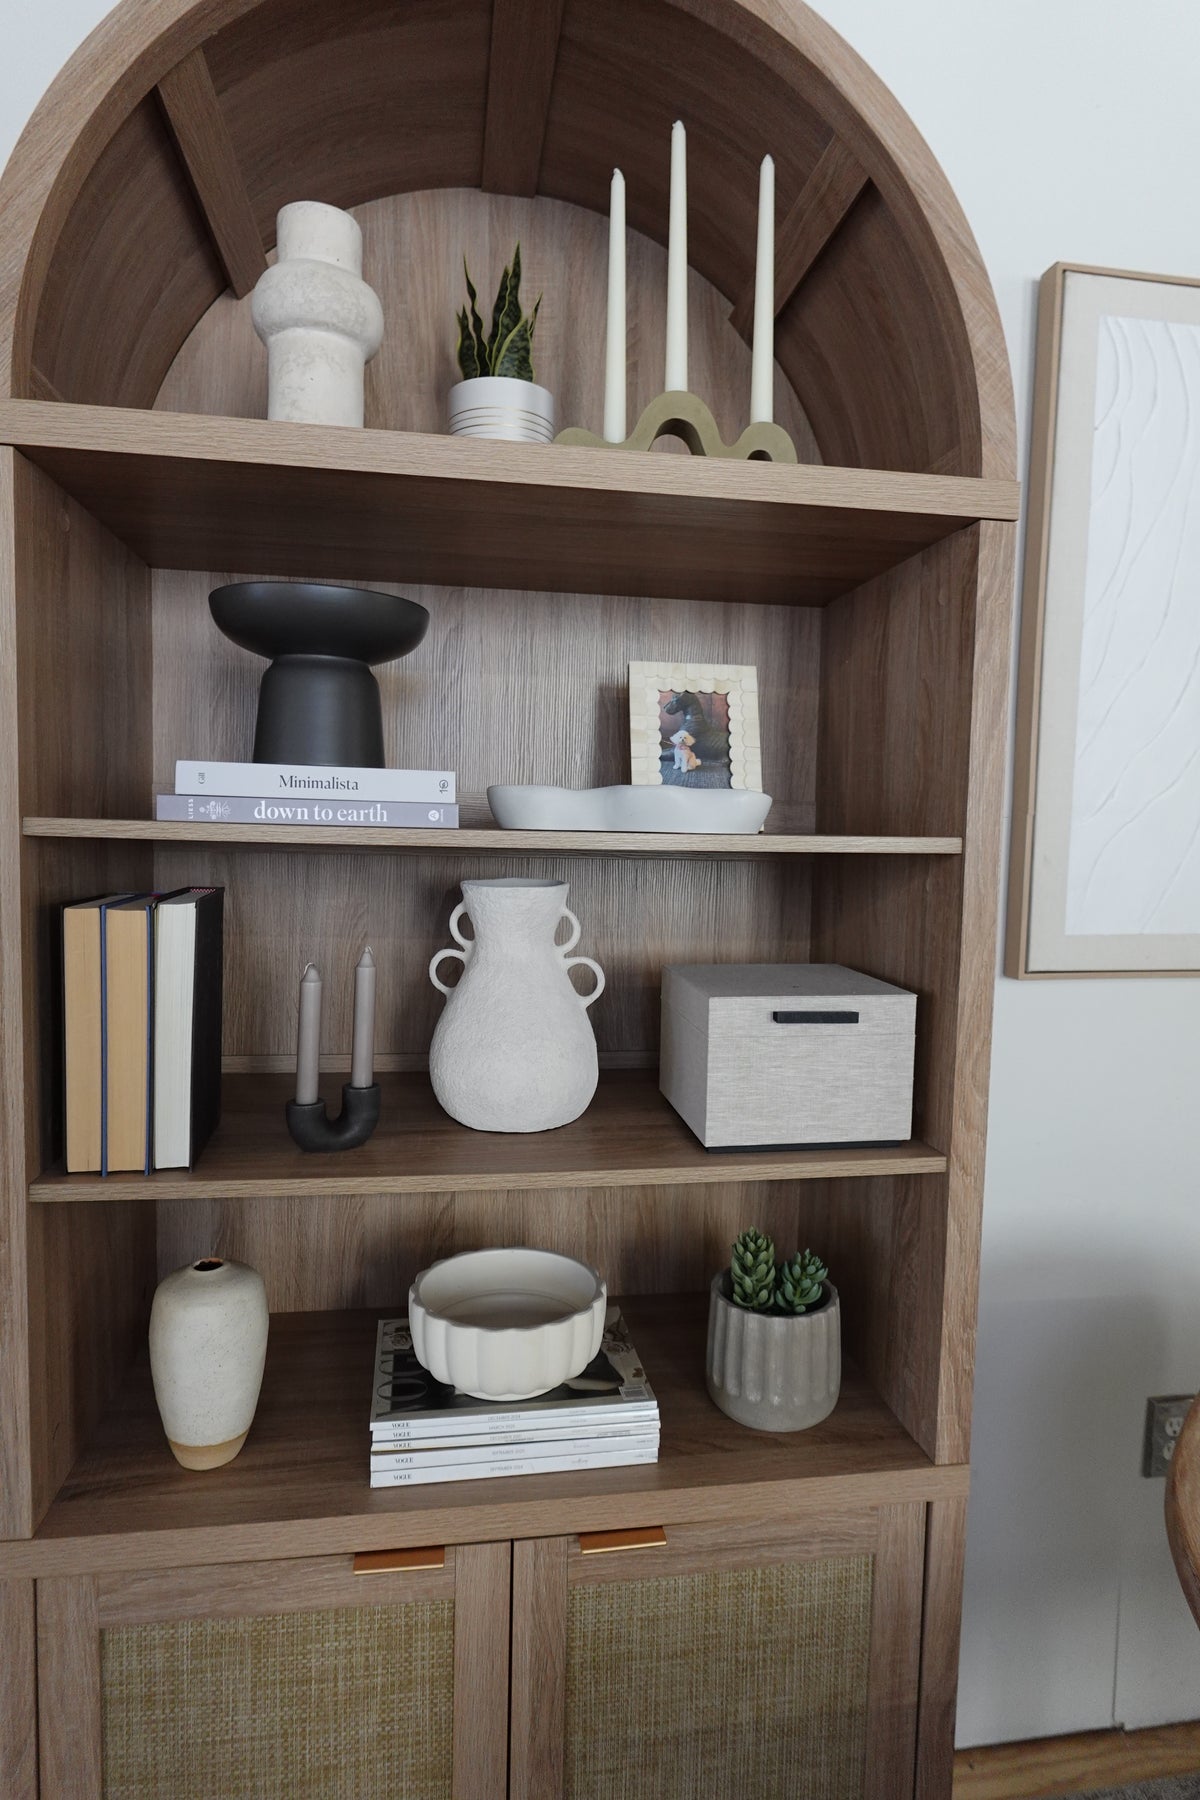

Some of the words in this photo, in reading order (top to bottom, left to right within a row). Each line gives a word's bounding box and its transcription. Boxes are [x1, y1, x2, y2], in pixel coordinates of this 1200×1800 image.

[279, 775, 359, 791] Minimalista
[254, 800, 309, 820] down
[313, 804, 333, 821] to
[336, 803, 388, 822] earth
